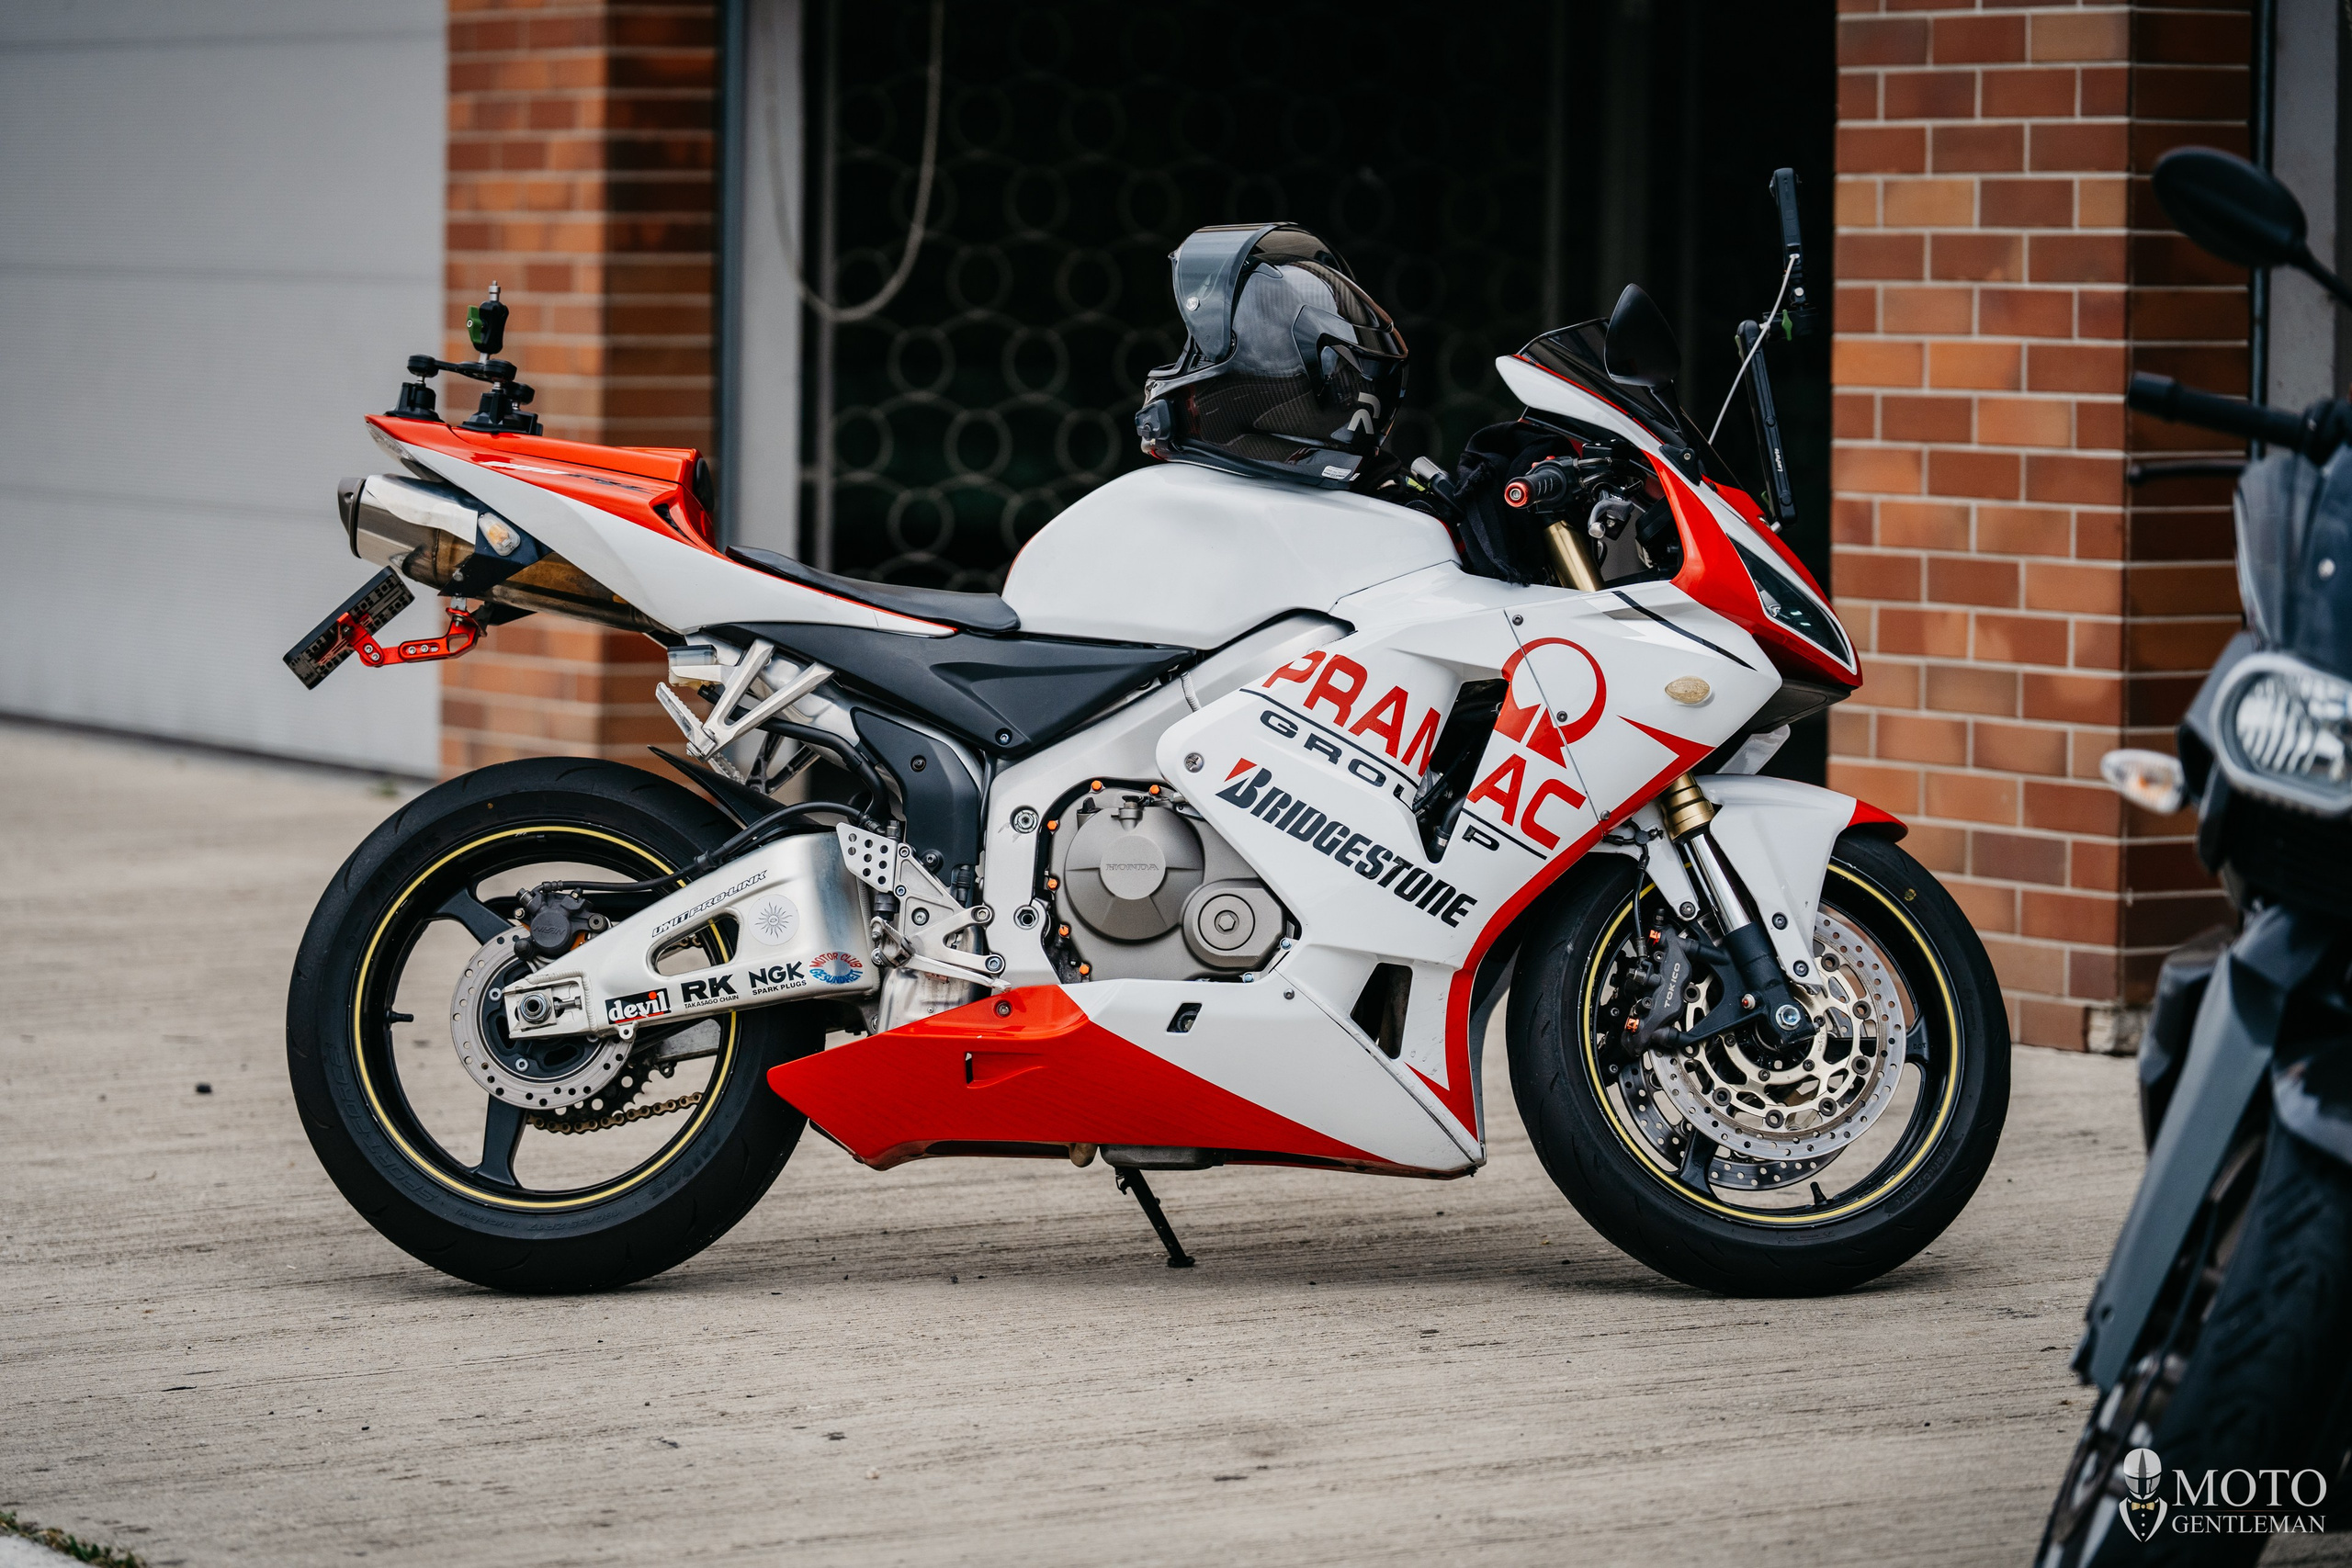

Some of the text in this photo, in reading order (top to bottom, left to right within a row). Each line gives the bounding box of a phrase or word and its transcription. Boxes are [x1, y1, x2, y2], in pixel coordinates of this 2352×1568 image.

[1215, 757, 1478, 929] BRIDGESTONE
[651, 869, 768, 938] UNIT PRO-LINK
[748, 960, 805, 988] NGK
[808, 952, 863, 968] MOTOR CLUB
[681, 974, 737, 1003] RK
[752, 979, 808, 996] SPARK PLUGS
[808, 968, 864, 985] GESUNDHEIT
[1664, 962, 1681, 1009] TOKICO
[607, 990, 668, 1023] devil
[684, 994, 740, 1010] TAKASAGO CHAIN
